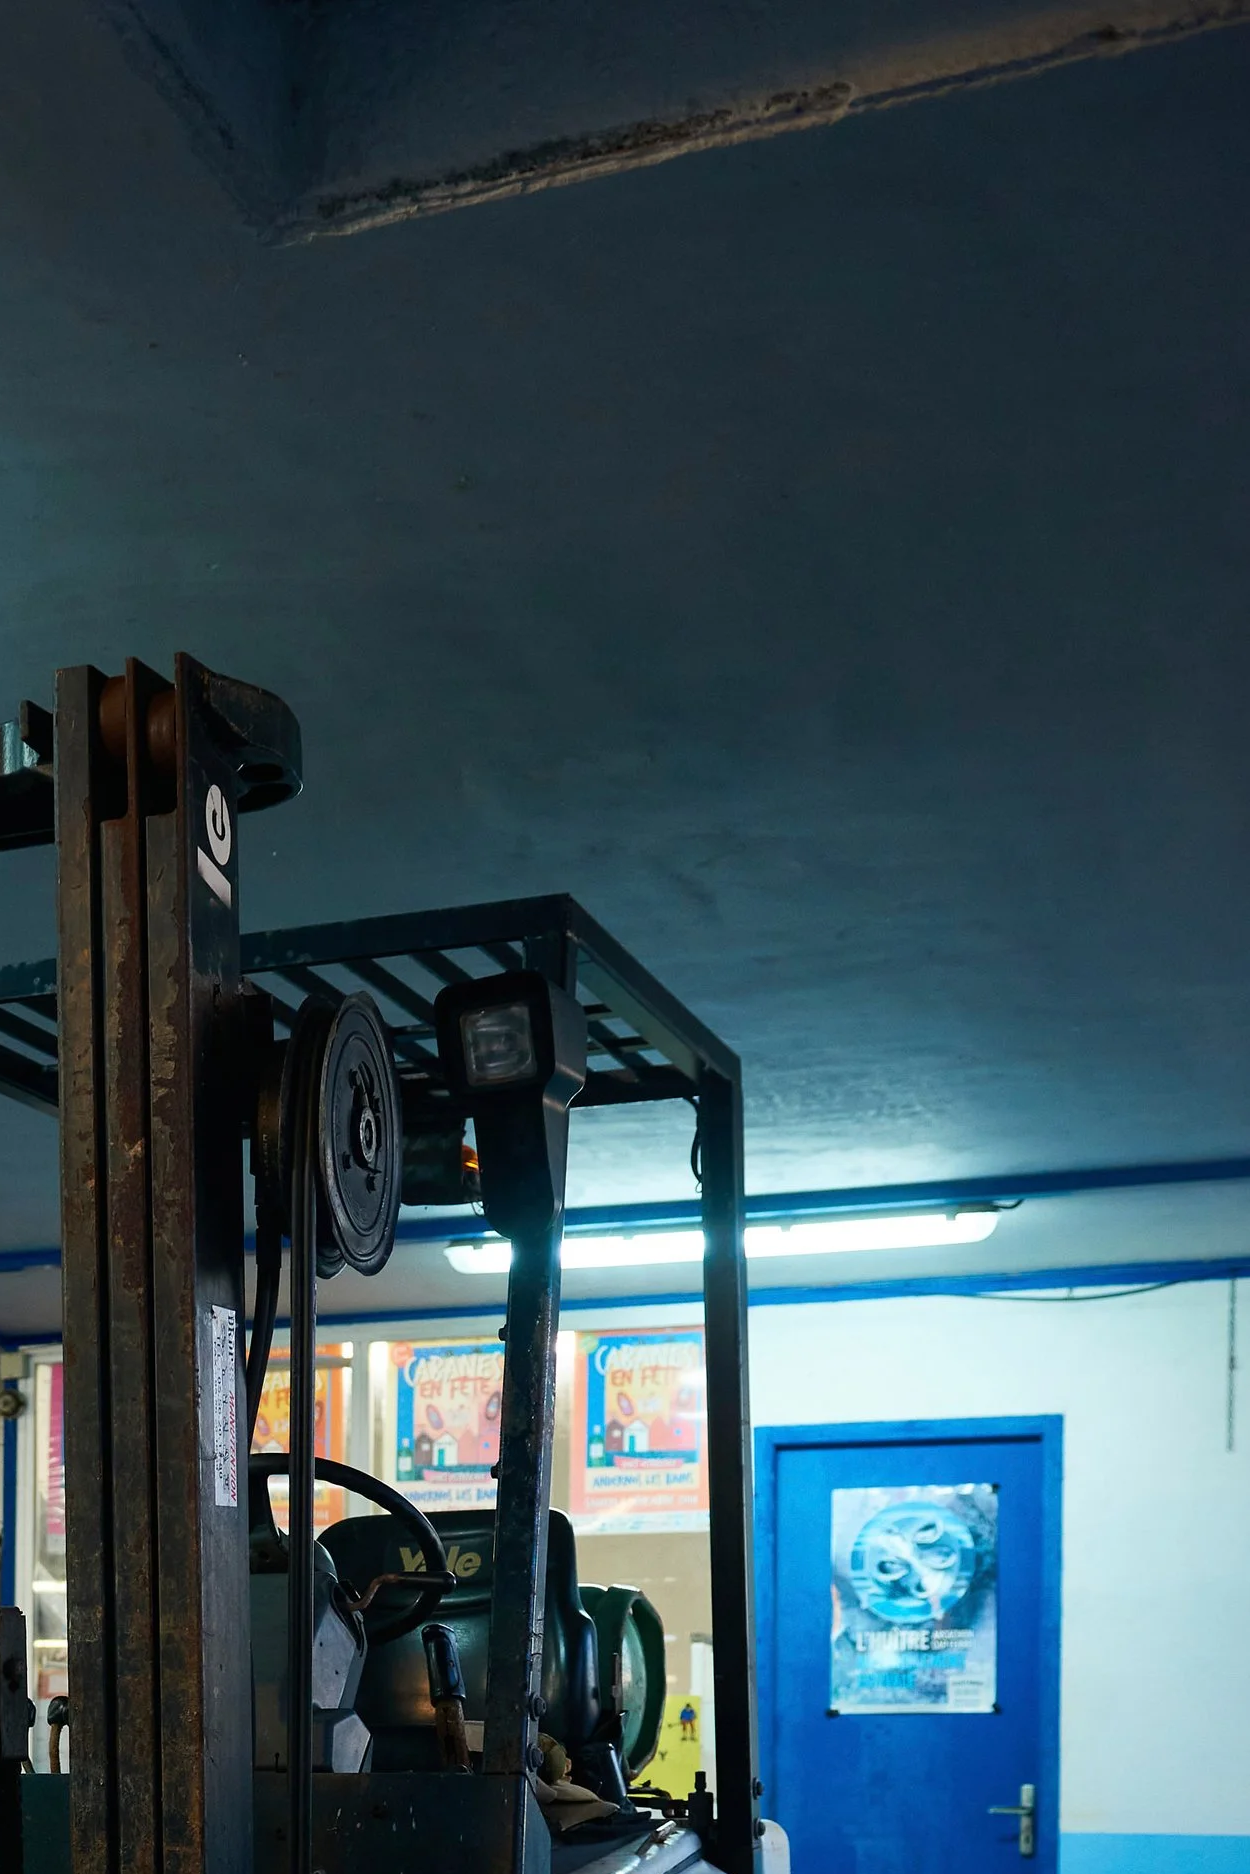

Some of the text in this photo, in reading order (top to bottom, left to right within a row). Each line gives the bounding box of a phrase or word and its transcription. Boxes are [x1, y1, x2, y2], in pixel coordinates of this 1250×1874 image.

[420, 1379, 442, 1398] EN
[610, 1368, 633, 1387] EN
[399, 1545, 482, 1577] Yle
[856, 1626, 931, 1652] L'HUÎTRE
